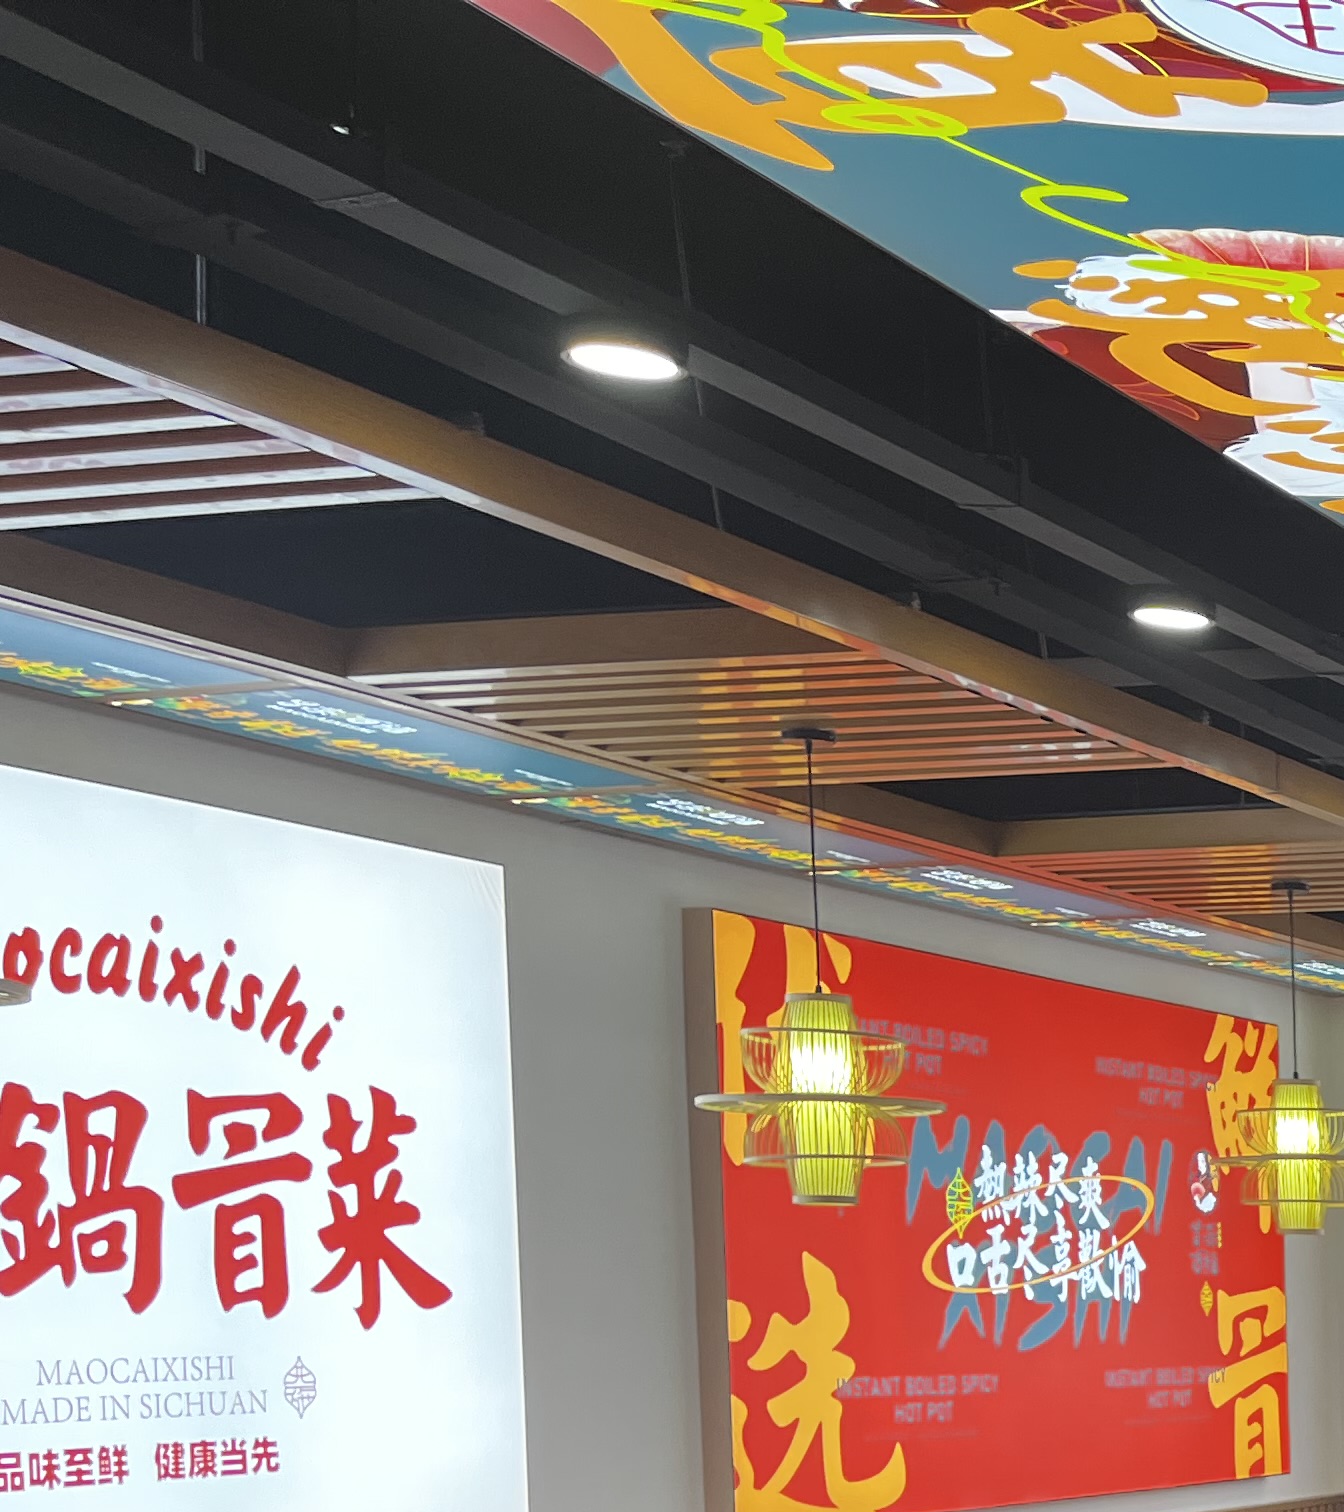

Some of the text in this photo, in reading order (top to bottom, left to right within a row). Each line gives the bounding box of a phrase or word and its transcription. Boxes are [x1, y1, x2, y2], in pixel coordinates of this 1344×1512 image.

[36, 1356, 236, 1386] MAOCAIXISHI
[2, 1389, 268, 1424] MADE IN SICHUAN
[0, 1436, 281, 1492] 品味至鲜 健康当先
